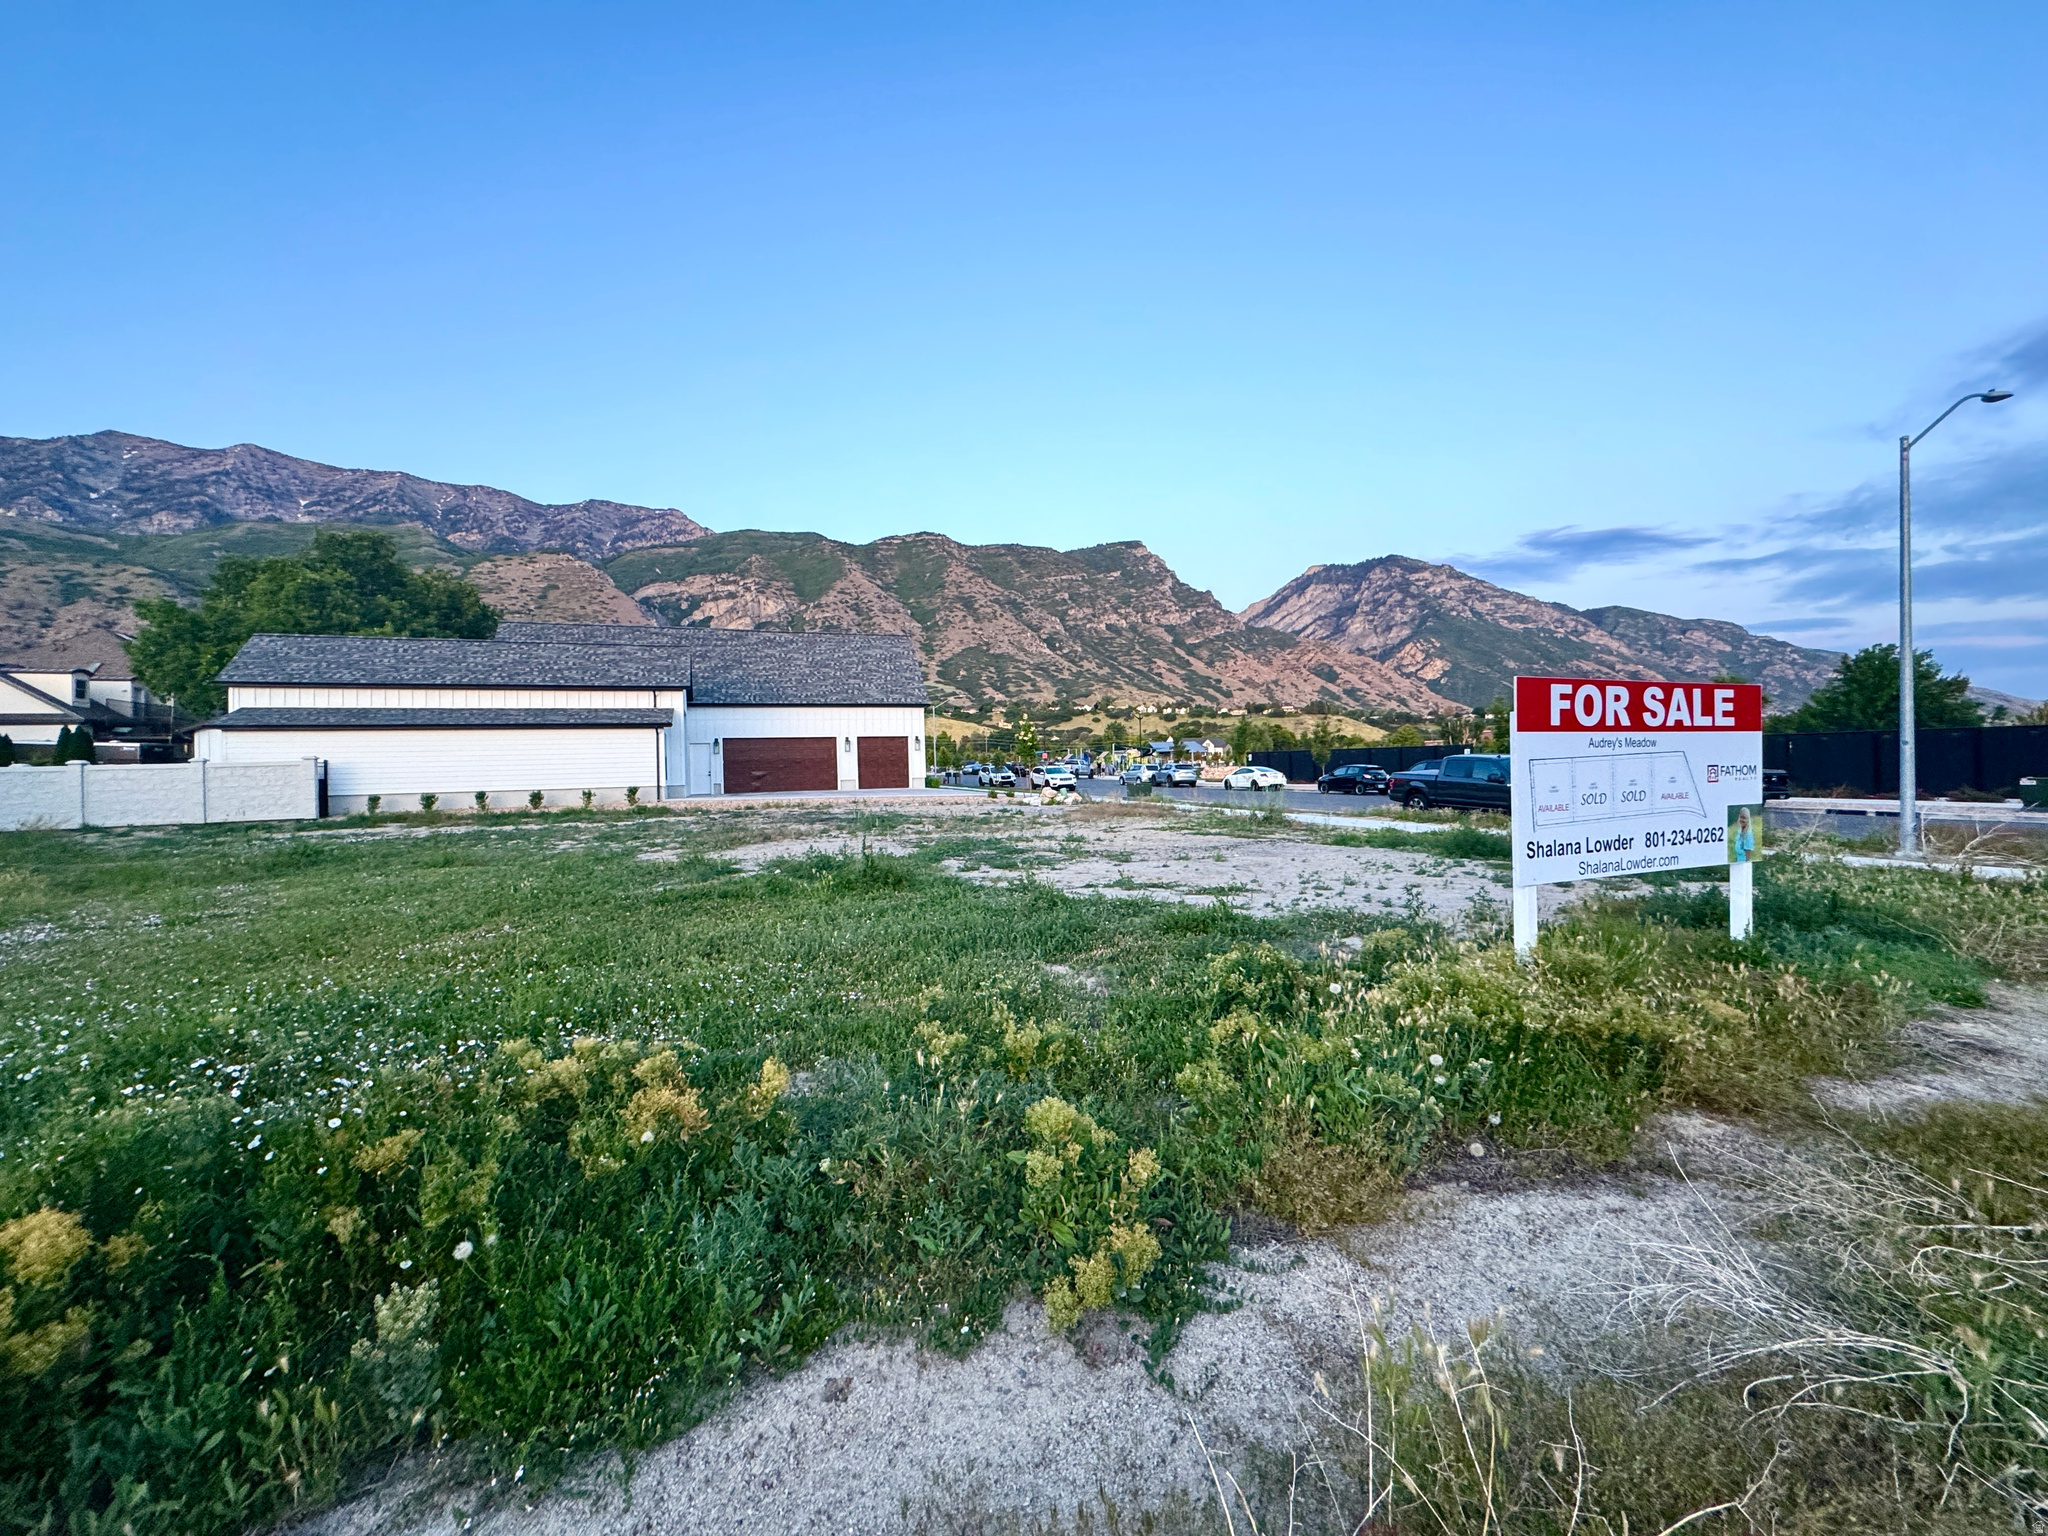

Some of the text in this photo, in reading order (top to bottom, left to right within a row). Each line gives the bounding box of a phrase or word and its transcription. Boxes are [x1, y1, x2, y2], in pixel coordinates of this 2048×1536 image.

[1550, 684, 1736, 727] FOR SALE
[1588, 737, 1657, 750] Audrey's Meadow
[1720, 764, 1757, 776] FATHOM
[1580, 792, 1607, 806] SOLD
[1620, 790, 1647, 803] SOLD
[1660, 792, 1690, 800] AVAILABLE
[1537, 803, 1570, 812] AVAILABLE
[1526, 826, 1725, 859] Shalana Lowder 801-234-0262
[1578, 854, 1680, 875] ShalanaLowder.com
